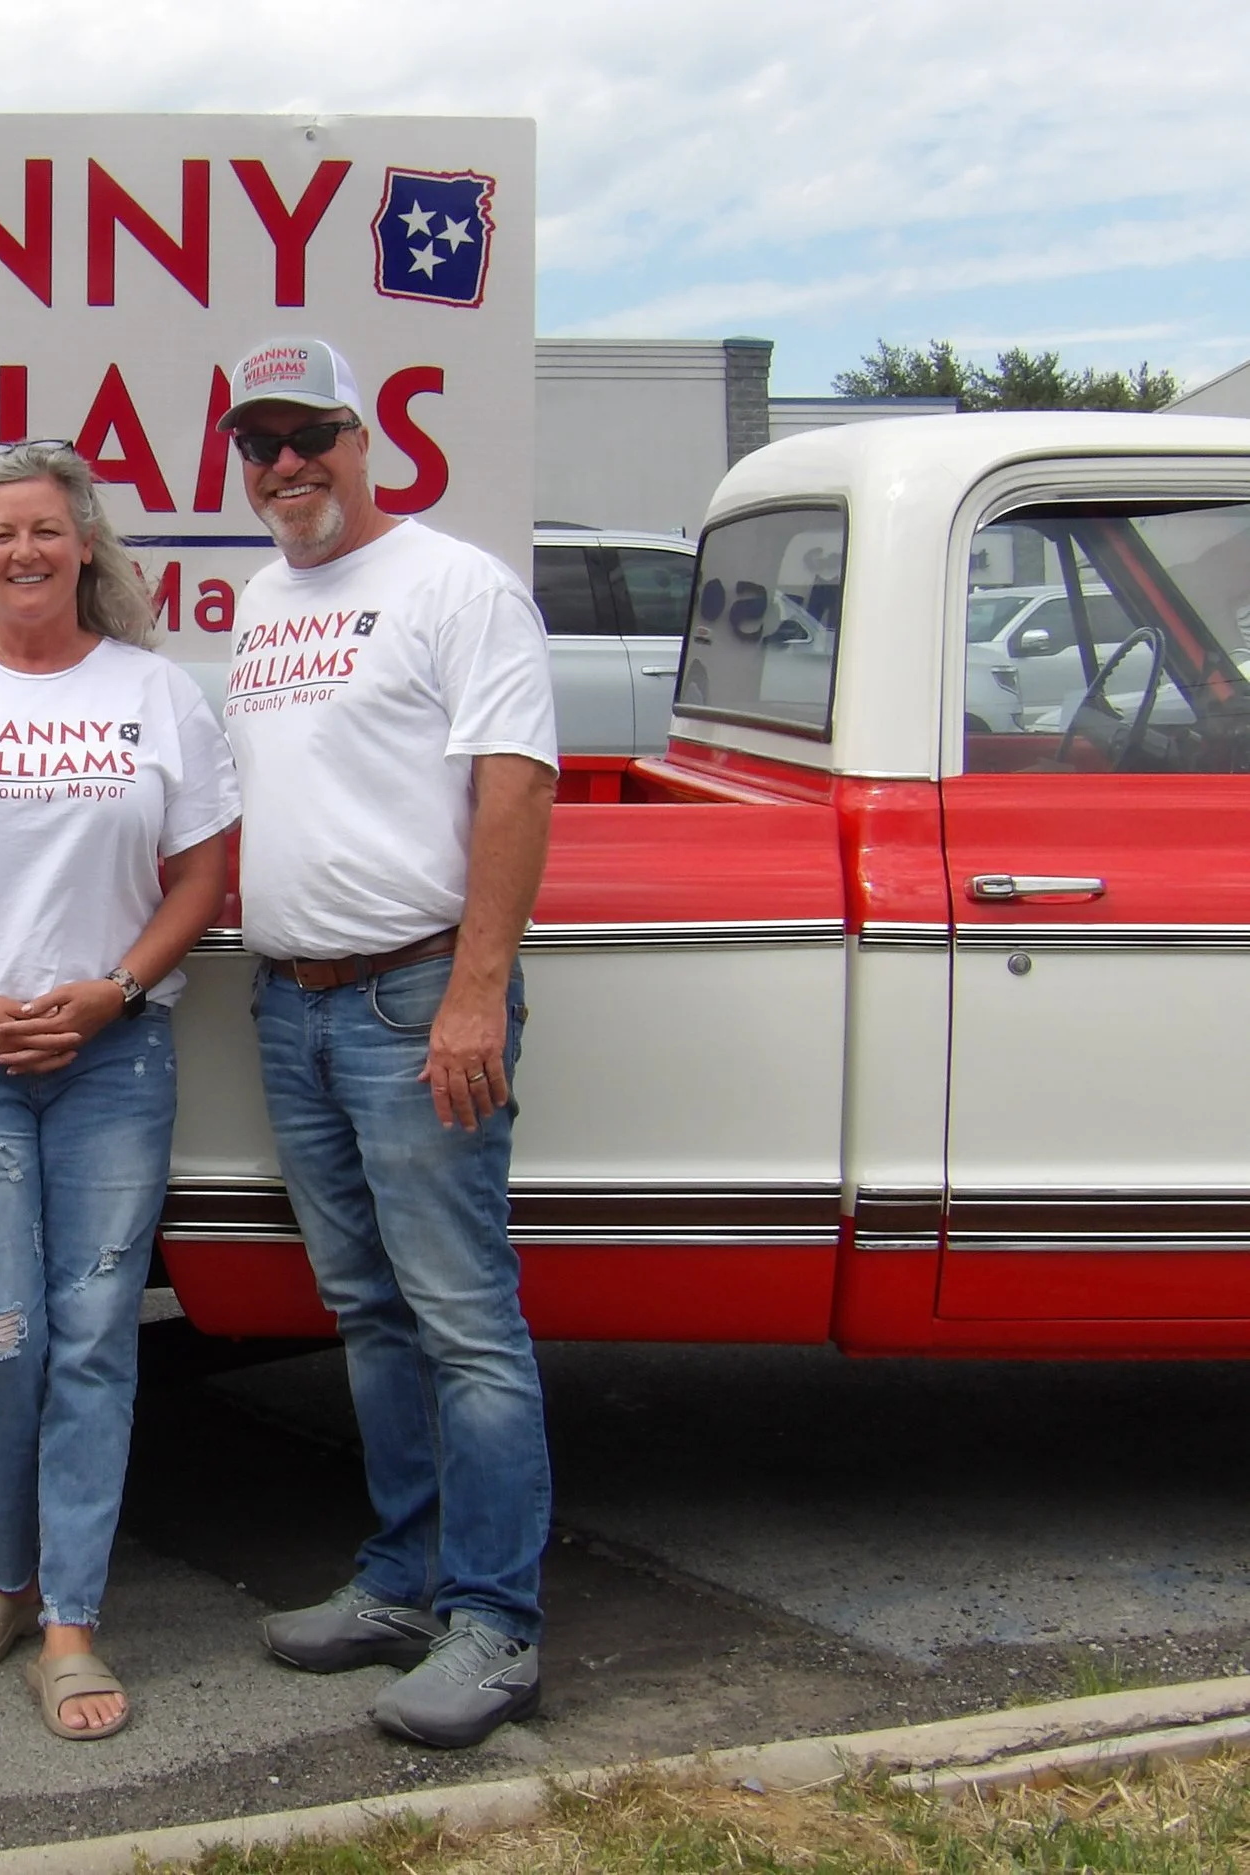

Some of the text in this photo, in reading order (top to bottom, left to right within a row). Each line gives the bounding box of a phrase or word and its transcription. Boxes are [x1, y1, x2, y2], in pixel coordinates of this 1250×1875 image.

[249, 348, 298, 368] DANNY
[244, 361, 306, 383] WILLIAMS
[248, 610, 358, 652] DANNY
[228, 648, 359, 695] WILLIAMS
[243, 694, 287, 713] County
[291, 688, 335, 705] Mayor
[68, 783, 126, 802] Mayor
